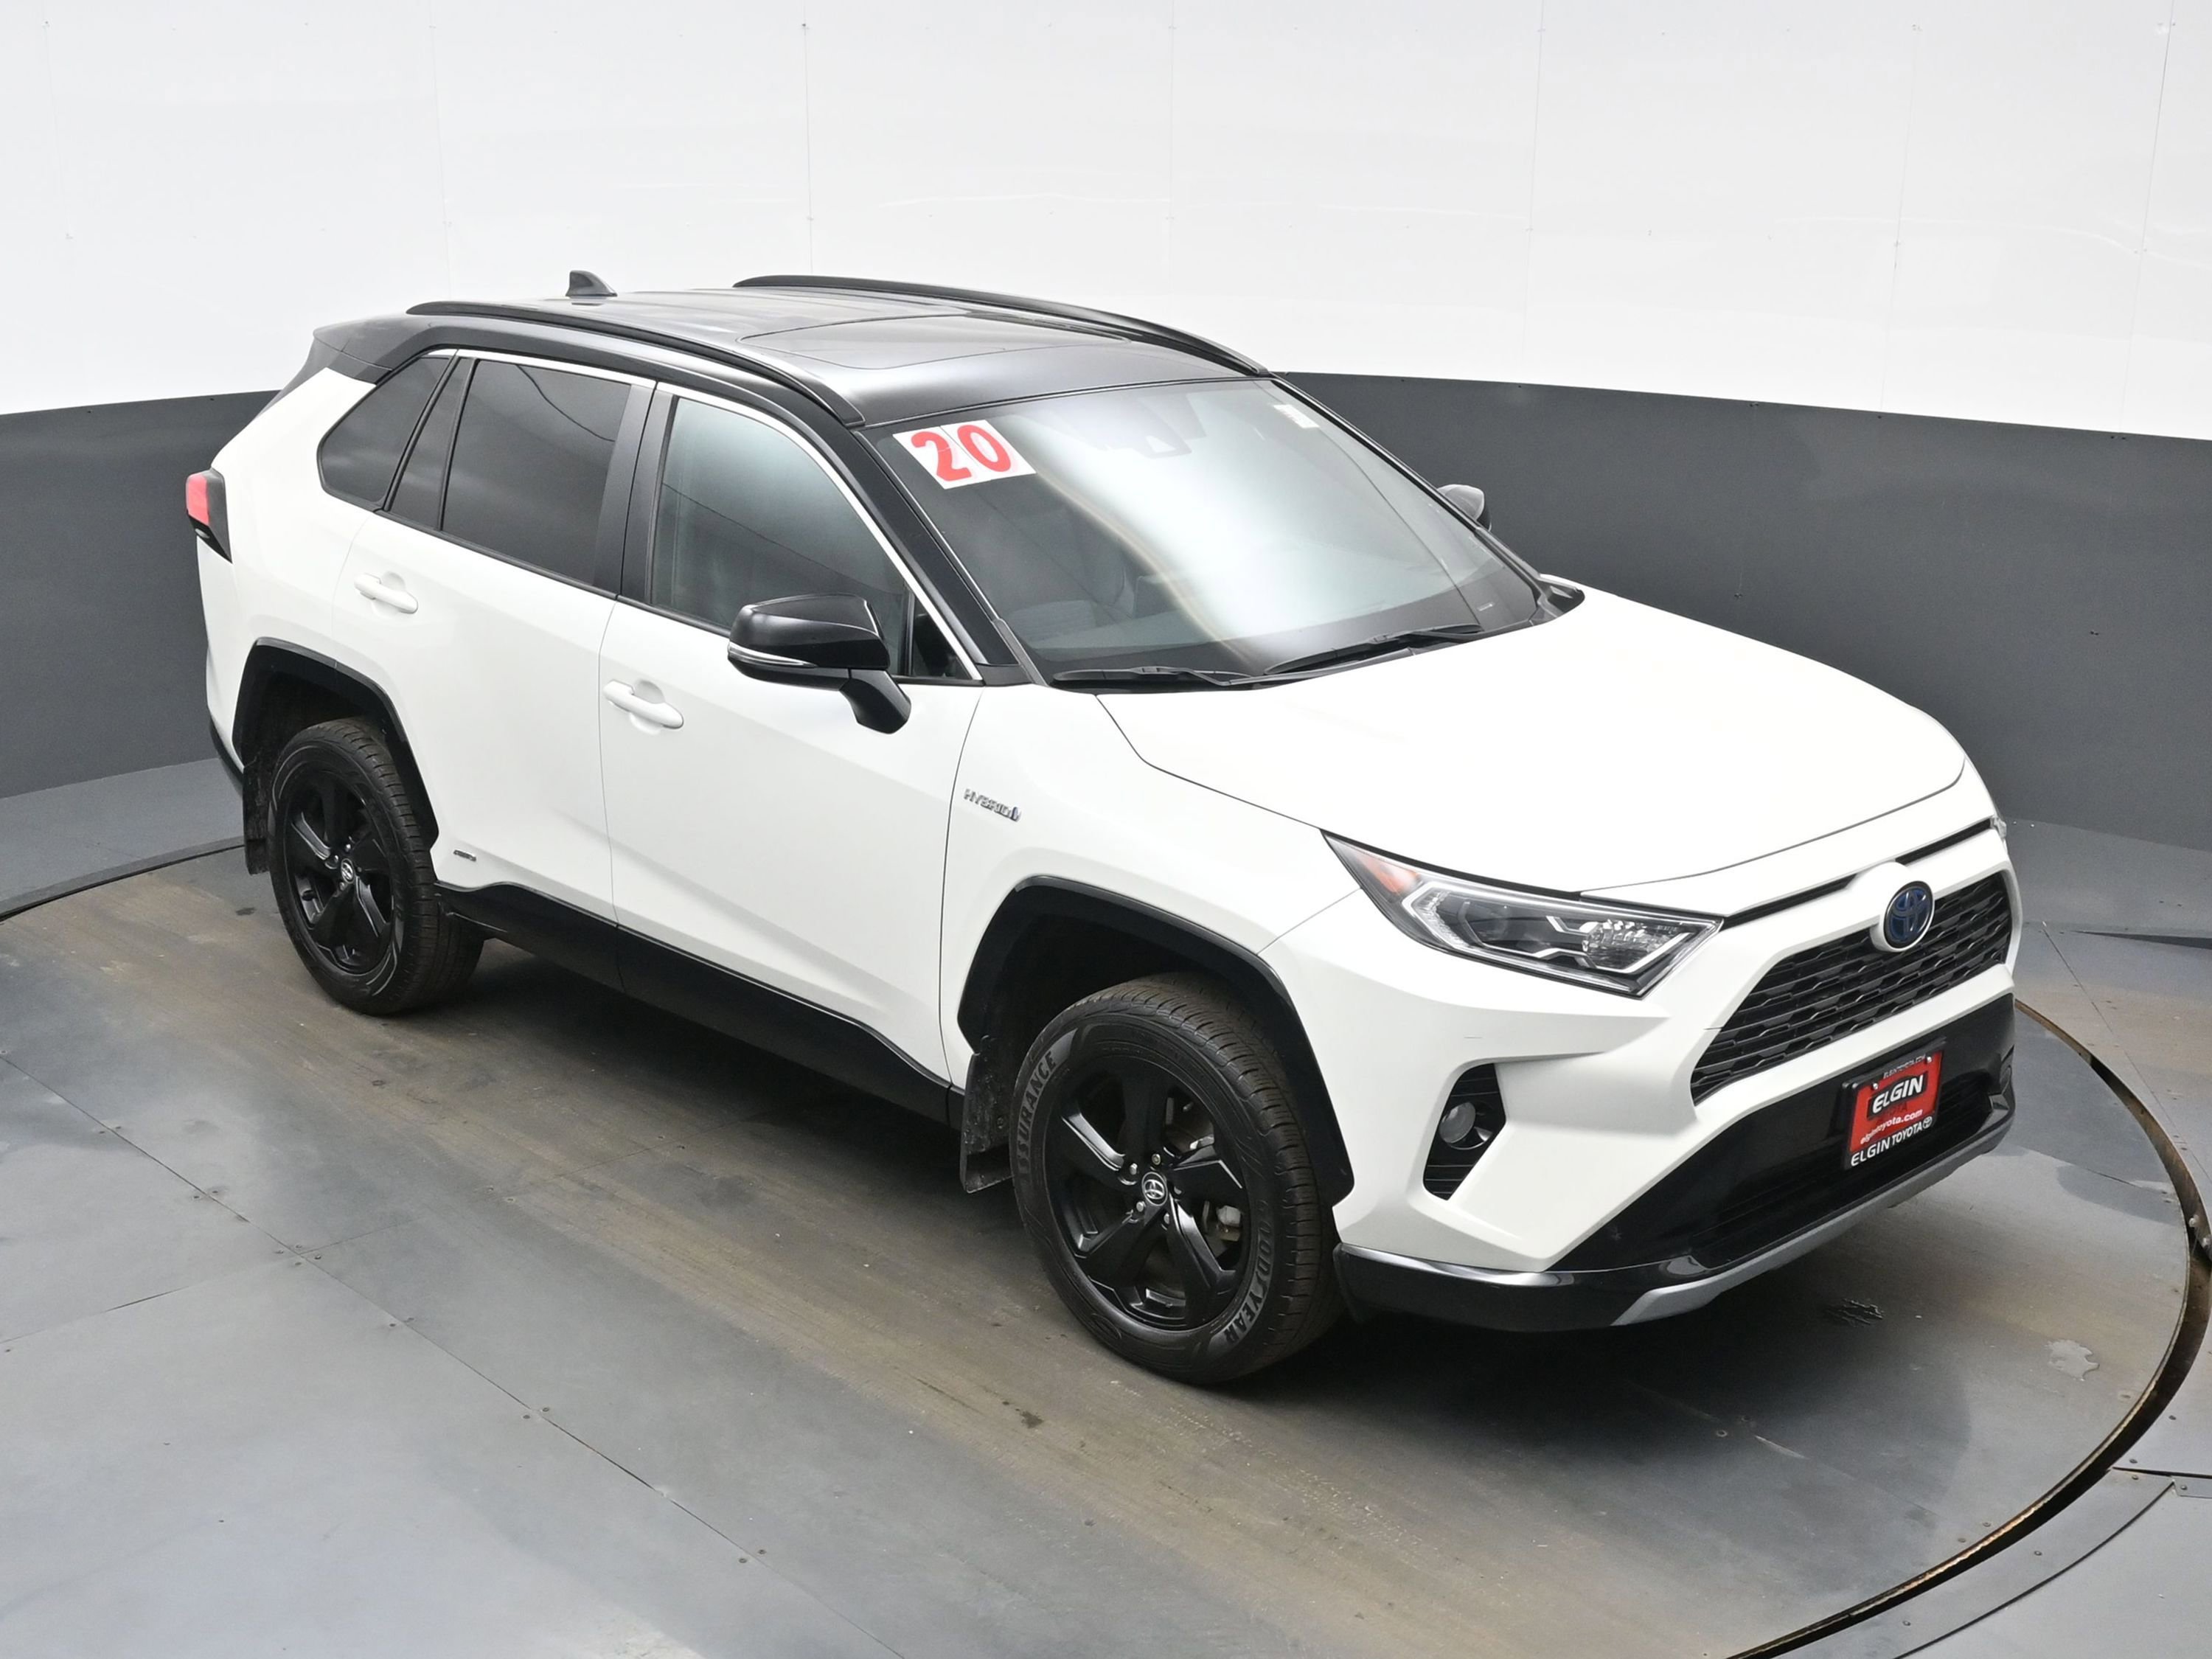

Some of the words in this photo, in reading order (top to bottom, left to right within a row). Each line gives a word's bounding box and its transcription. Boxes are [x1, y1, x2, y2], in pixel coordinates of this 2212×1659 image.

[911, 425, 1011, 481] 20
[1017, 1050, 1057, 1181] SSURANCE
[1871, 1074, 1924, 1113] ELGIN
[1851, 1137, 1890, 1166] ELGIN
[1891, 1121, 1923, 1147] TOYOTA
